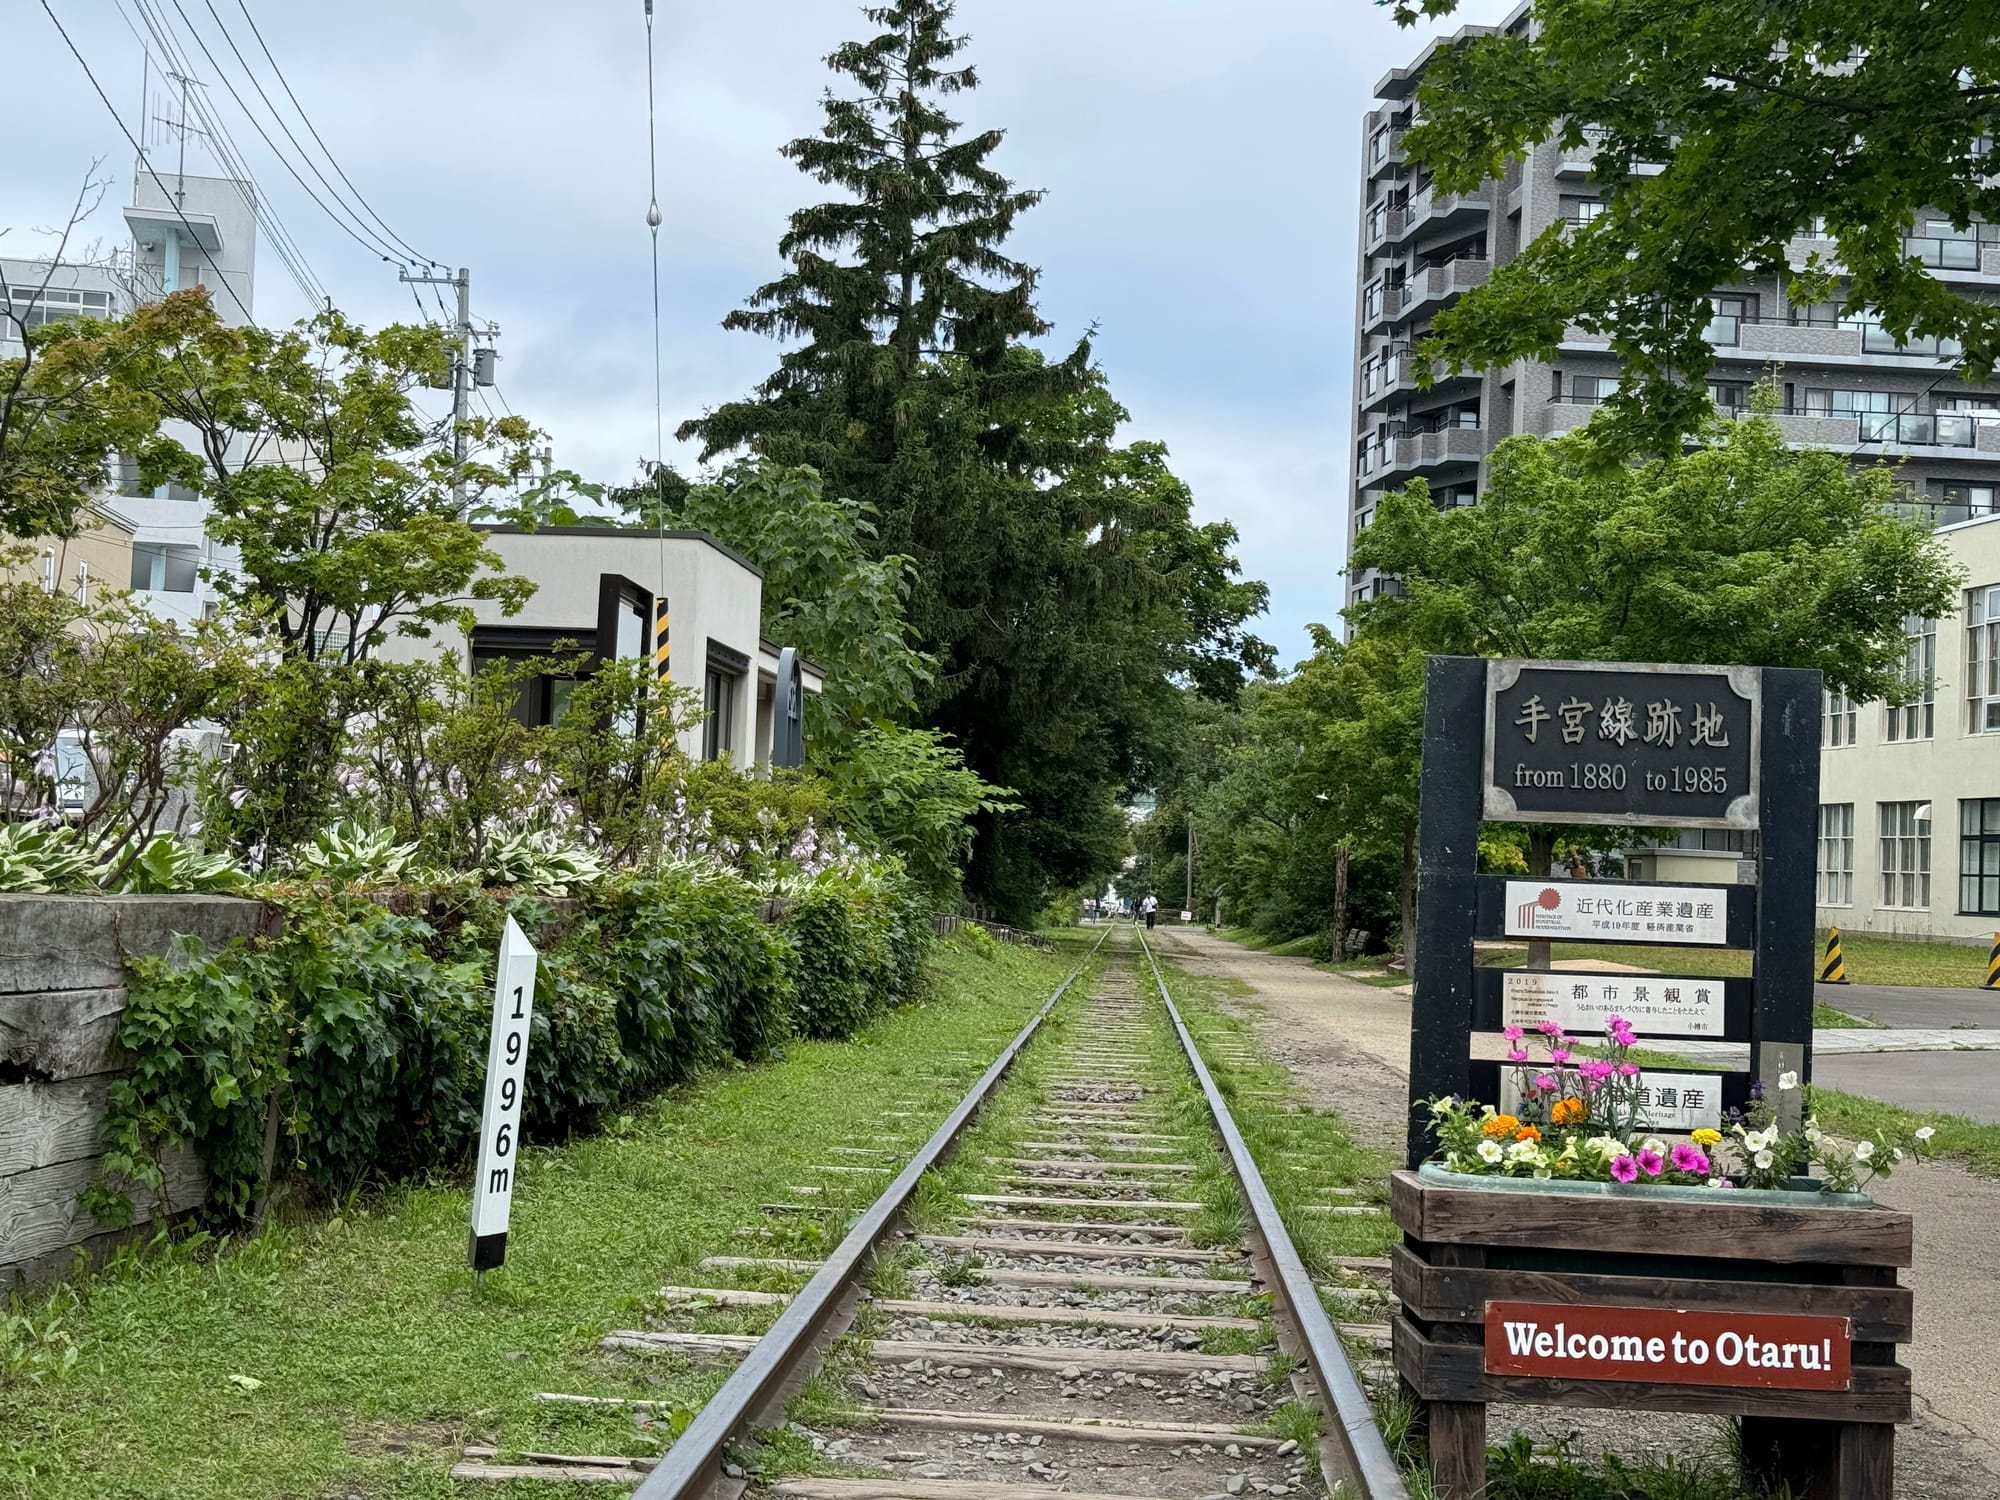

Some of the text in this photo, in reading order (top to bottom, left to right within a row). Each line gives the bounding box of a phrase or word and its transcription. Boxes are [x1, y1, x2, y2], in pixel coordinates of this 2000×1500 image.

[1514, 694, 1729, 748] 手宮線跡地
[1514, 762, 1728, 794] from 1880 to 1985
[1576, 897, 1715, 920] 近代化産業遺産
[1507, 978, 1538, 986] 2019
[1571, 983, 1711, 1005] 都市景観賞
[489, 986, 525, 1195] 1996m
[1504, 1322, 1832, 1371] Welcome to Otaru!
